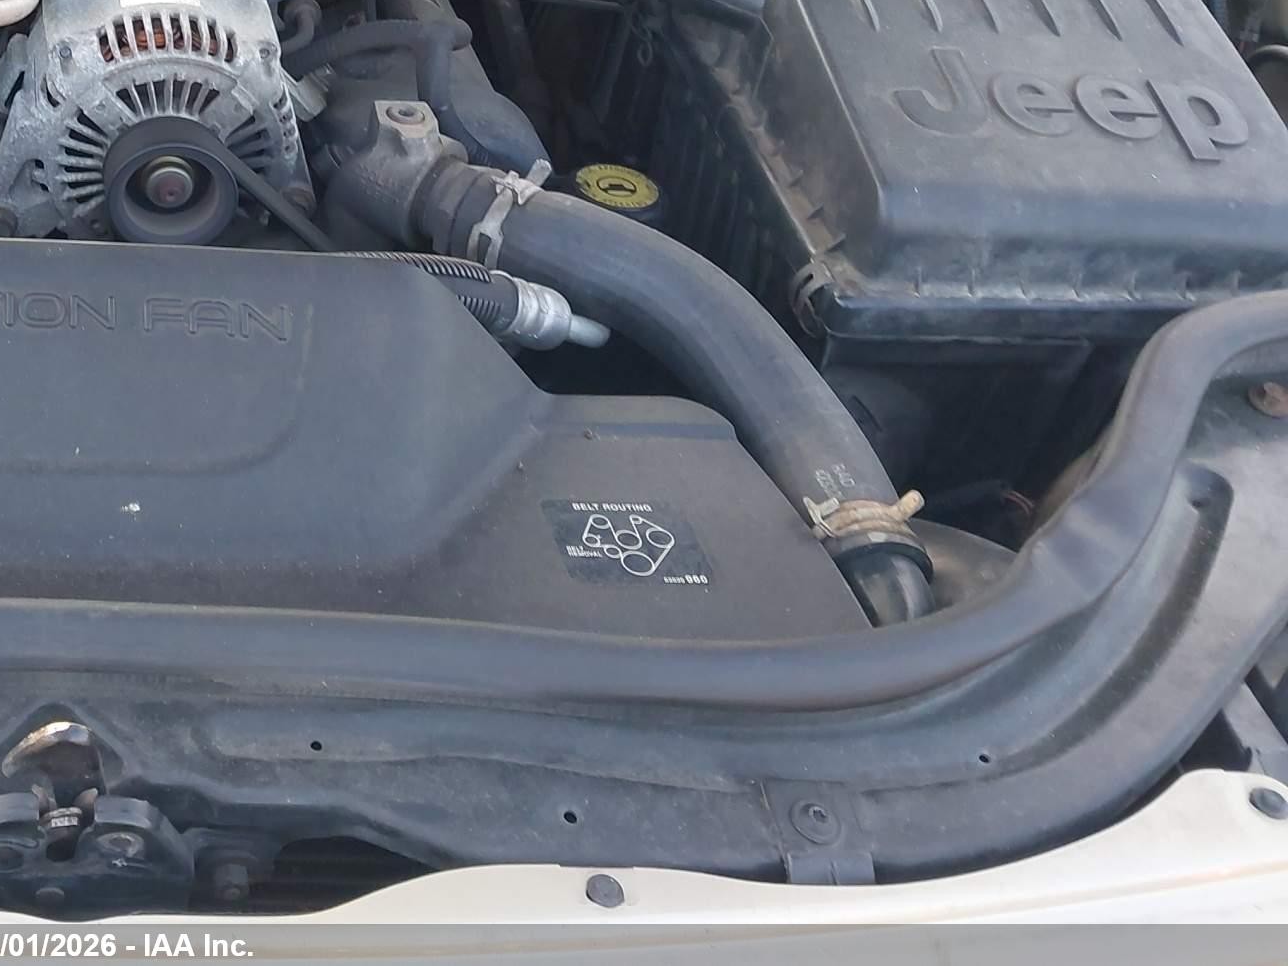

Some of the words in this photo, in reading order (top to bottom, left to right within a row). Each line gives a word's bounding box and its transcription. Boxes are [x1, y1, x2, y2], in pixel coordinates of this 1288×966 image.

[893, 46, 1250, 163] Jeep
[142, 297, 289, 341] FAN
[572, 502, 601, 511] BELT
[603, 503, 653, 512] ROUTING
